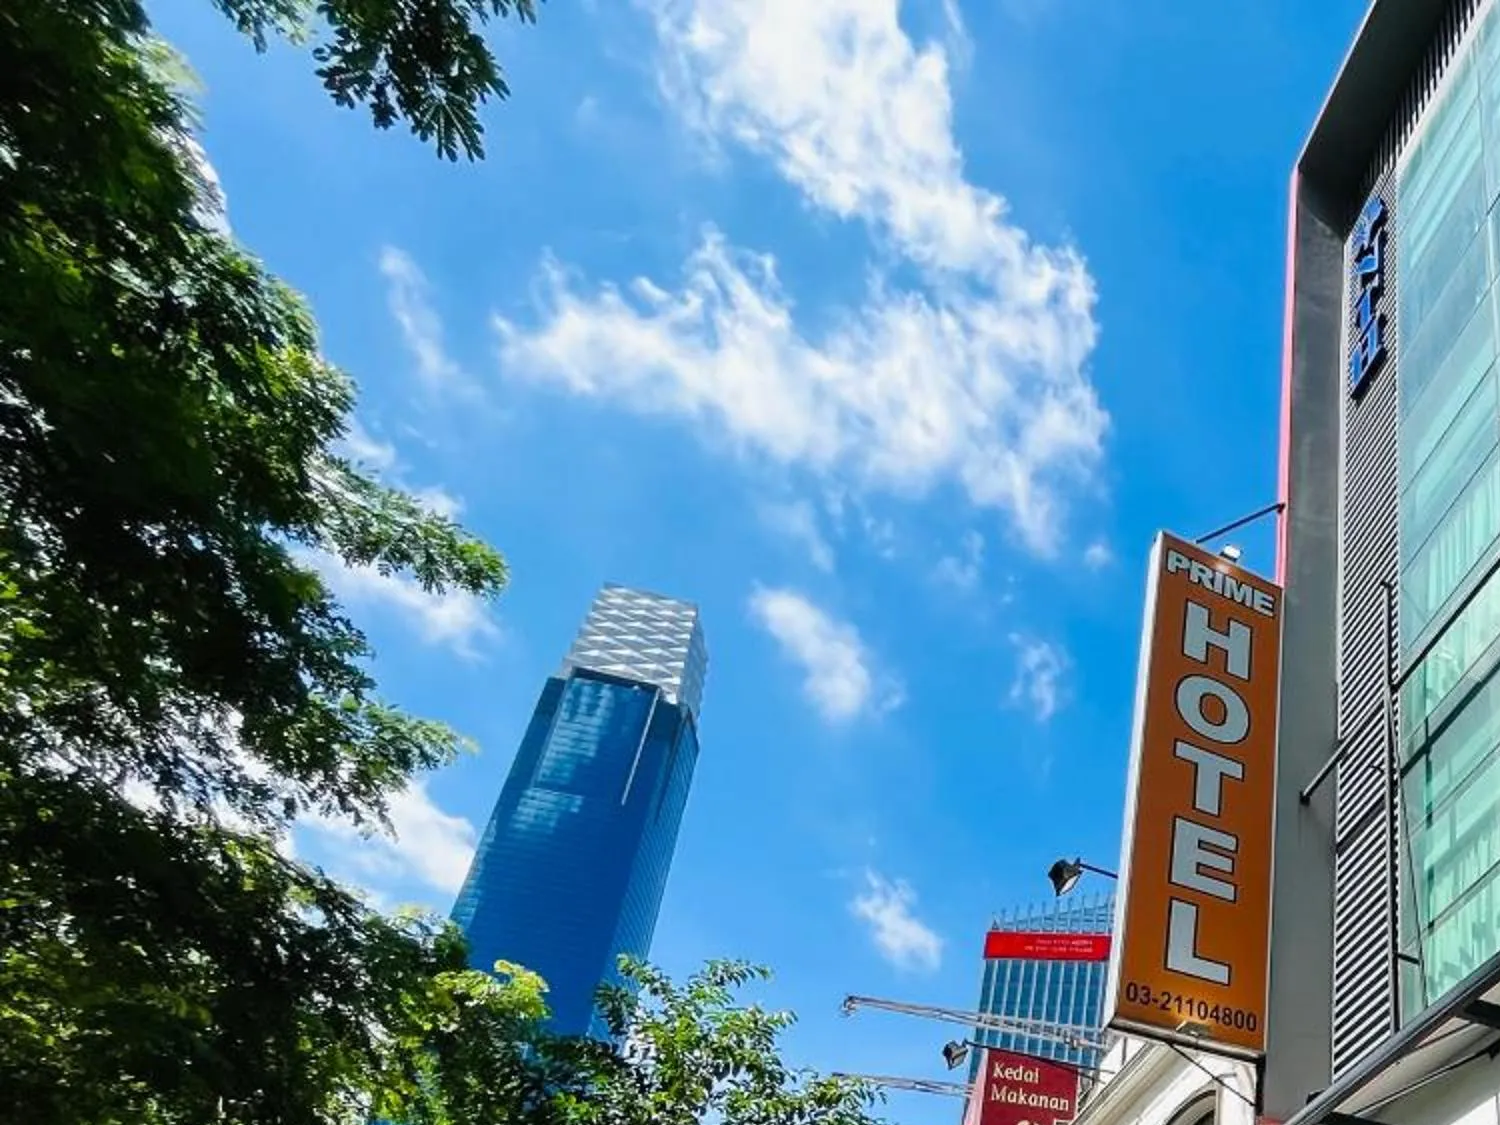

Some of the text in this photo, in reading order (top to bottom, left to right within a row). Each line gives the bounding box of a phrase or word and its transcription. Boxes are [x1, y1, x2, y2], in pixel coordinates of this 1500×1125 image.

[1166, 548, 1275, 618] PRIME
[1163, 600, 1252, 987] HOTEL
[1125, 981, 1258, 1034] 03-21104800
[991, 1083, 1069, 1112] Makanan
[993, 1061, 1040, 1084] Kedai
